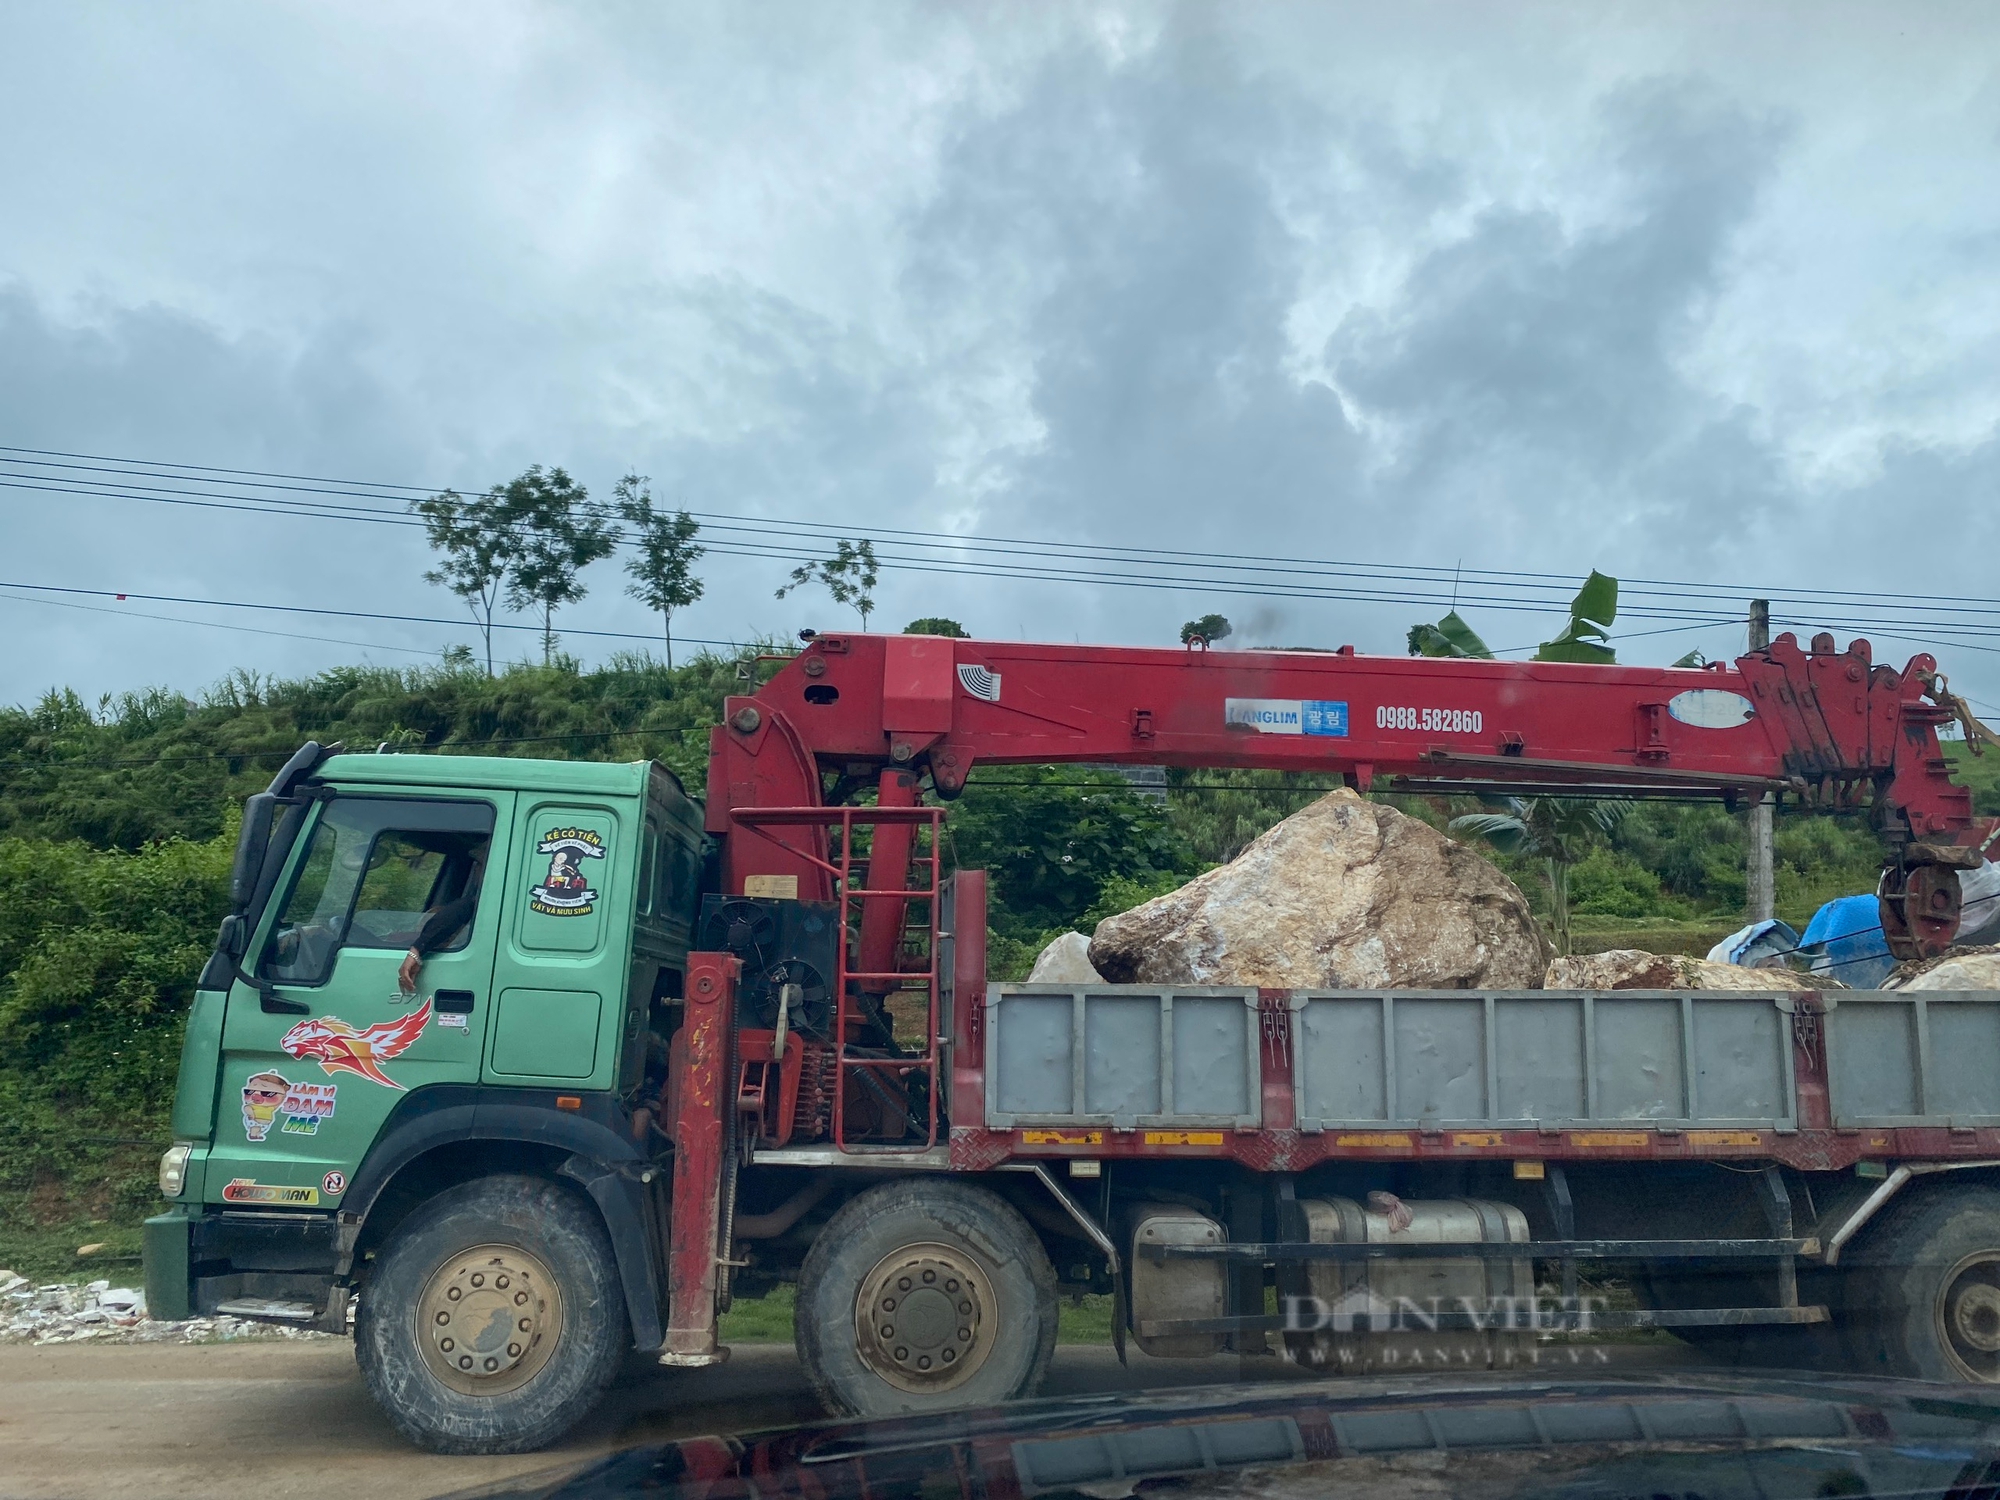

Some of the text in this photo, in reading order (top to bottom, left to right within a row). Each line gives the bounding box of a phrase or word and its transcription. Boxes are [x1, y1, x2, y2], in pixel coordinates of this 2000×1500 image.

[1376, 706, 1483, 734] 0988.582860
[574, 906, 591, 914] SINH
[292, 1083, 335, 1097] LÀM VÌ
[283, 1096, 334, 1116] ĐAM
[283, 1115, 319, 1133] MÊ
[231, 1187, 311, 1201] HOWO MAN
